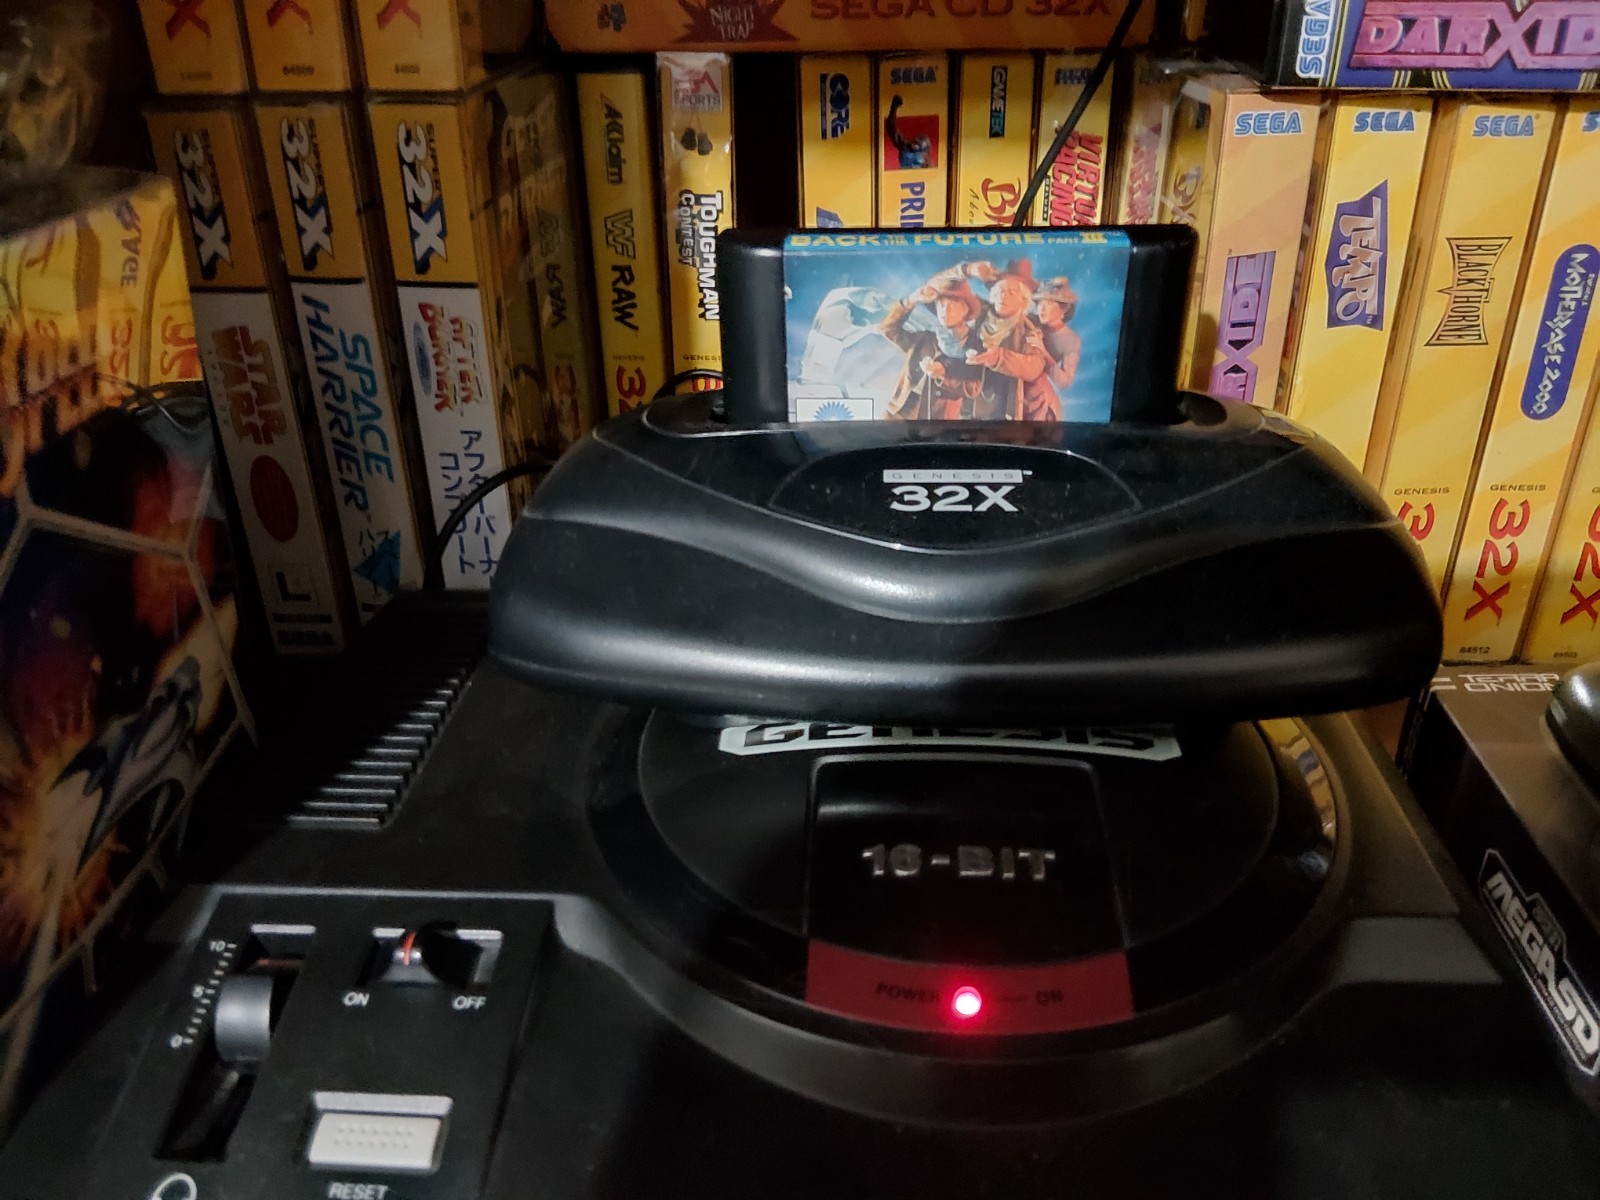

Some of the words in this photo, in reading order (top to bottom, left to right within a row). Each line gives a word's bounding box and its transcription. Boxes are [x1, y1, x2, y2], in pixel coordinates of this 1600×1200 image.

[1297, 0, 1333, 78] SEGA
[890, 68, 934, 85] SEGA
[829, 73, 850, 139] CORE
[1234, 112, 1302, 136] SEGA
[1354, 111, 1415, 132] SEGA
[1473, 114, 1534, 137] SEGA
[281, 118, 334, 270] 32X
[398, 120, 448, 273] 32X
[677, 188, 697, 266] CONTEST
[789, 234, 880, 247] BACK
[913, 233, 1044, 246] FUTURE
[699, 190, 724, 321] TOUGHMAN
[1331, 196, 1384, 321] TEMPO
[611, 264, 640, 331] RAW
[1436, 243, 1504, 342] BLACKTHORNE
[300, 294, 371, 515] HARRIER
[338, 327, 396, 484] SPACE
[1530, 367, 1561, 415] 2000
[889, 485, 1019, 512] 32X
[891, 472, 1014, 480] GENESIS
[1394, 487, 1450, 496] GENESIS
[1490, 484, 1547, 492] GENESIS
[1464, 498, 1530, 627] 32X
[342, 992, 371, 1008] ON
[452, 995, 487, 1011] OFF
[327, 1183, 390, 1200] RESET
